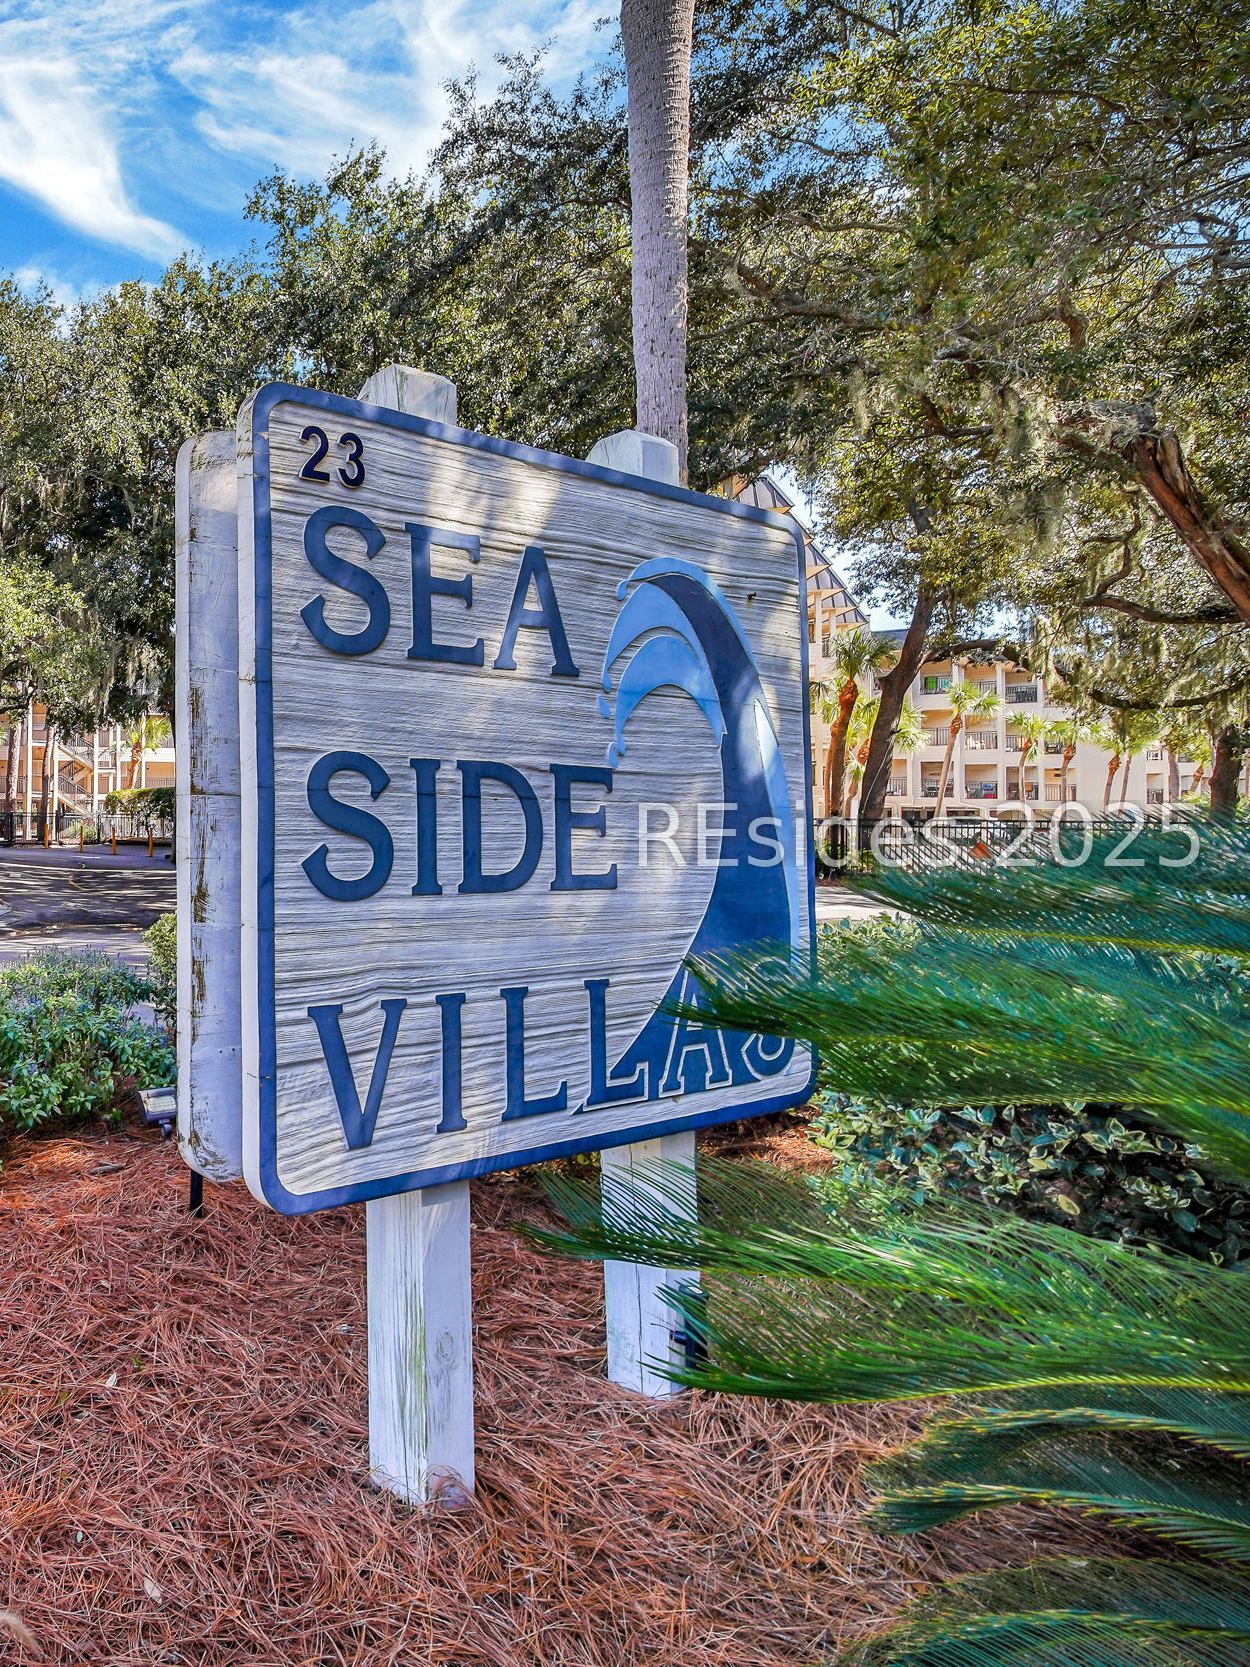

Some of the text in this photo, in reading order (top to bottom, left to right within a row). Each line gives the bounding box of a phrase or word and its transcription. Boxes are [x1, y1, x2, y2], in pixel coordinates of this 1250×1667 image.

[299, 425, 365, 489] 23
[301, 506, 580, 678] SEA
[301, 750, 618, 901] SIDE
